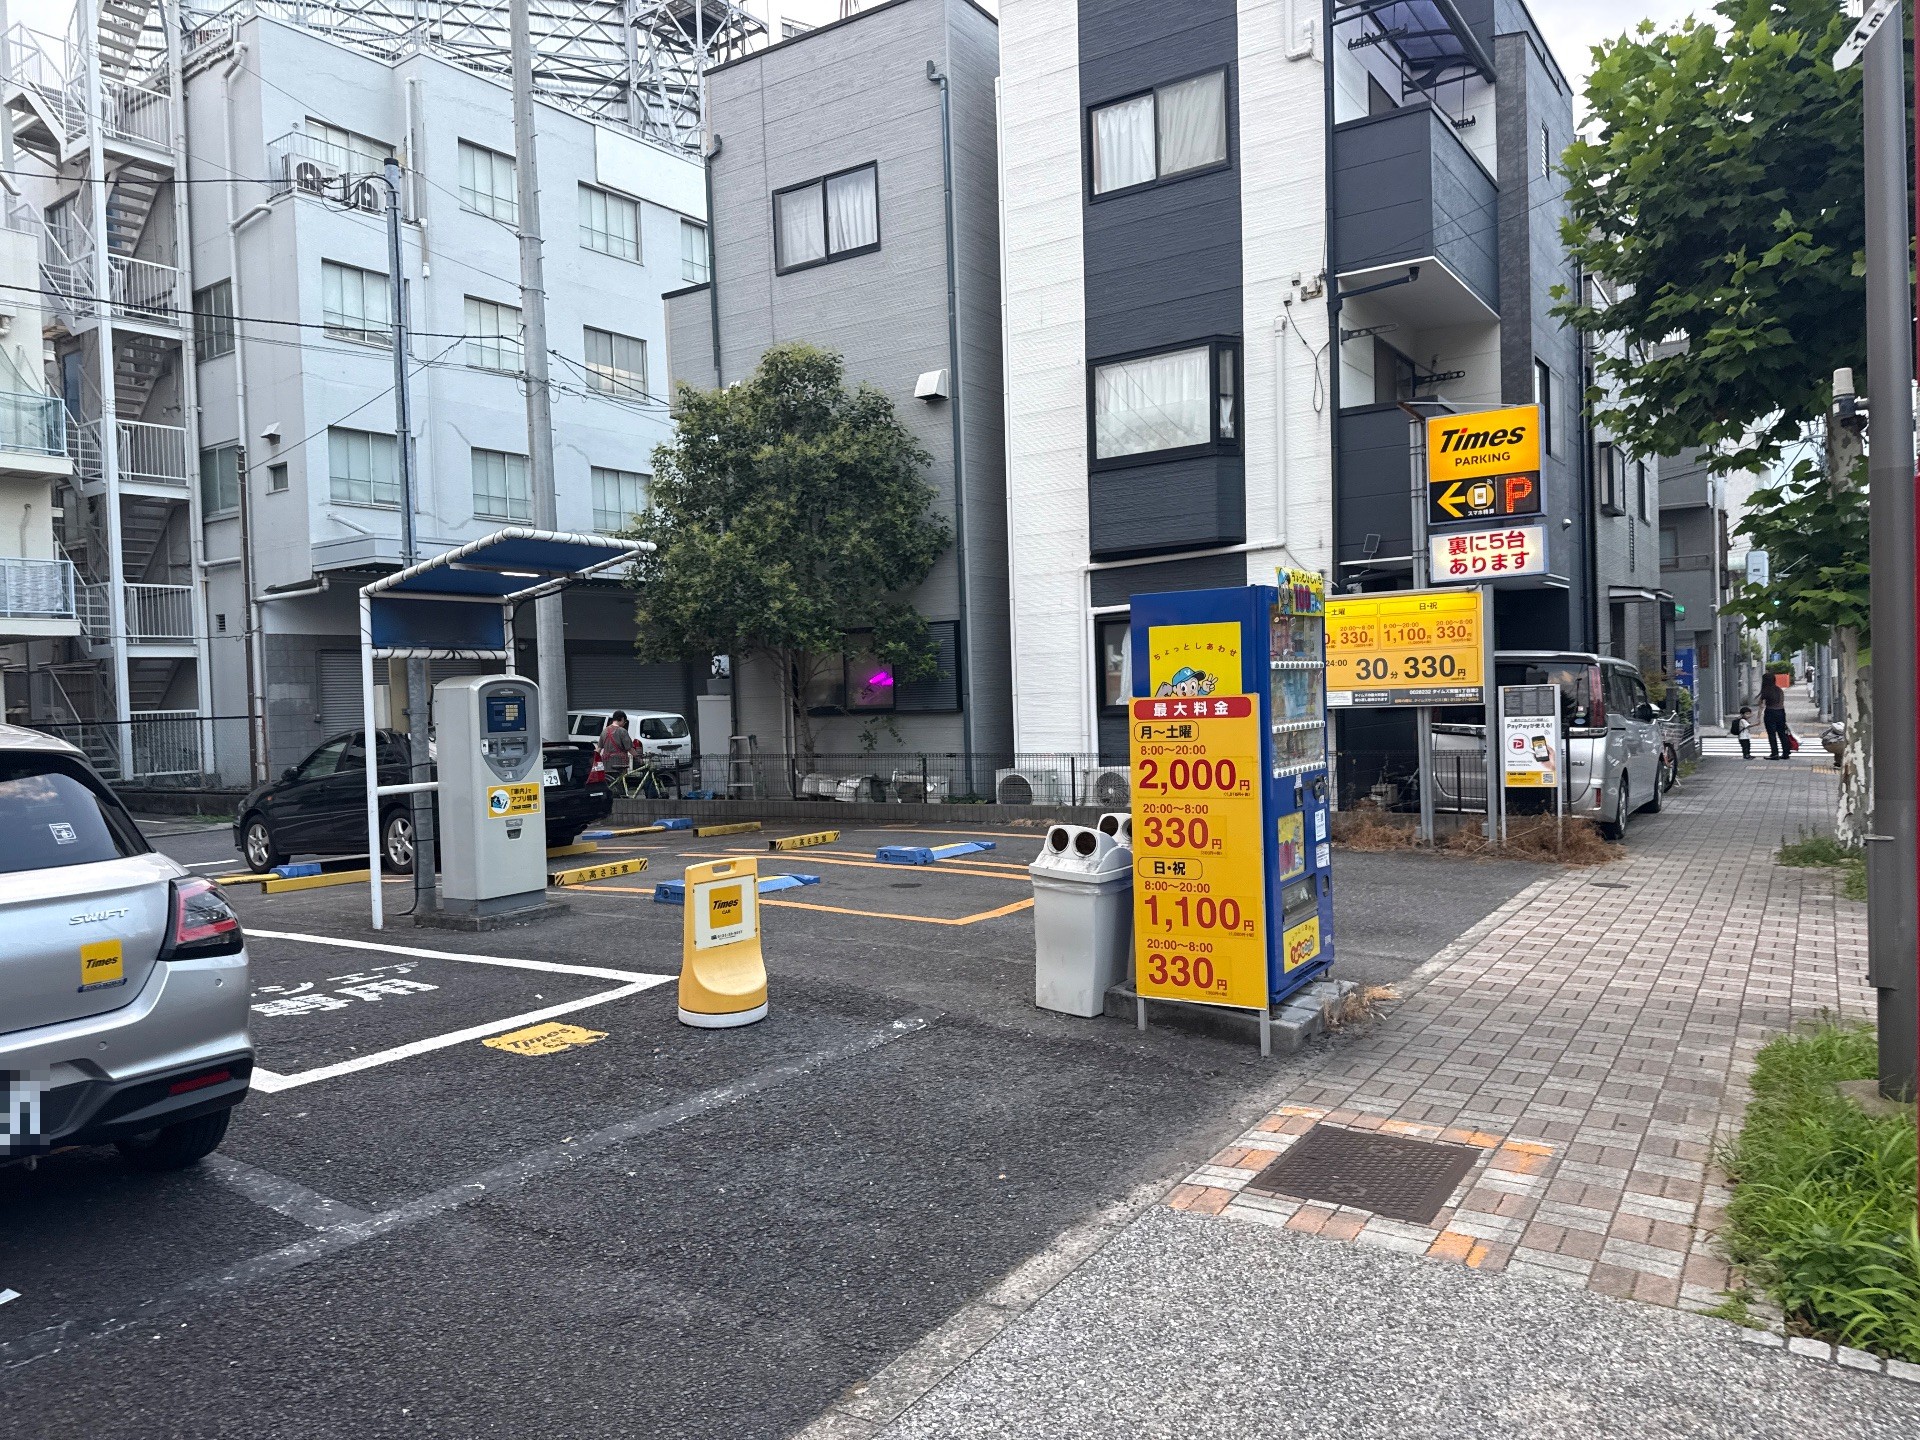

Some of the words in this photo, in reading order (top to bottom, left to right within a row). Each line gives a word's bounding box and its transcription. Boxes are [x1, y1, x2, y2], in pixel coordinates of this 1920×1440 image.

[1440, 426, 1526, 453] Times
[1455, 452, 1511, 467] PARKING
[1447, 530, 1526, 555] 裏に5台
[1449, 551, 1530, 575] あります
[1340, 631, 1374, 645] 330円
[1384, 628, 1432, 643] 1,100円
[1436, 625, 1472, 639] 330円
[1153, 642, 1238, 661] ちょっとしあわせ
[1355, 657, 1398, 681] 30分
[1404, 654, 1466, 679] 330円
[1153, 700, 1229, 717] 最大料金
[1140, 724, 1193, 740] 月〜土曜
[1140, 745, 1206, 755] 8:00〜20:00
[1138, 759, 1251, 796] 2,000円
[1143, 803, 1209, 814] 20:00〜8:00
[1143, 816, 1222, 850] 330円
[588, 864, 629, 880] 高さ注意
[1154, 860, 1186, 876] 日・祝
[1144, 880, 1211, 893] 8:00〜20:00
[712, 899, 739, 910] Times
[69, 907, 130, 926] SWIFT
[1144, 894, 1255, 932] 1,100円
[1146, 938, 1213, 953] 20:00〜8:00
[85, 956, 119, 969] Times
[1148, 953, 1228, 991] 330円
